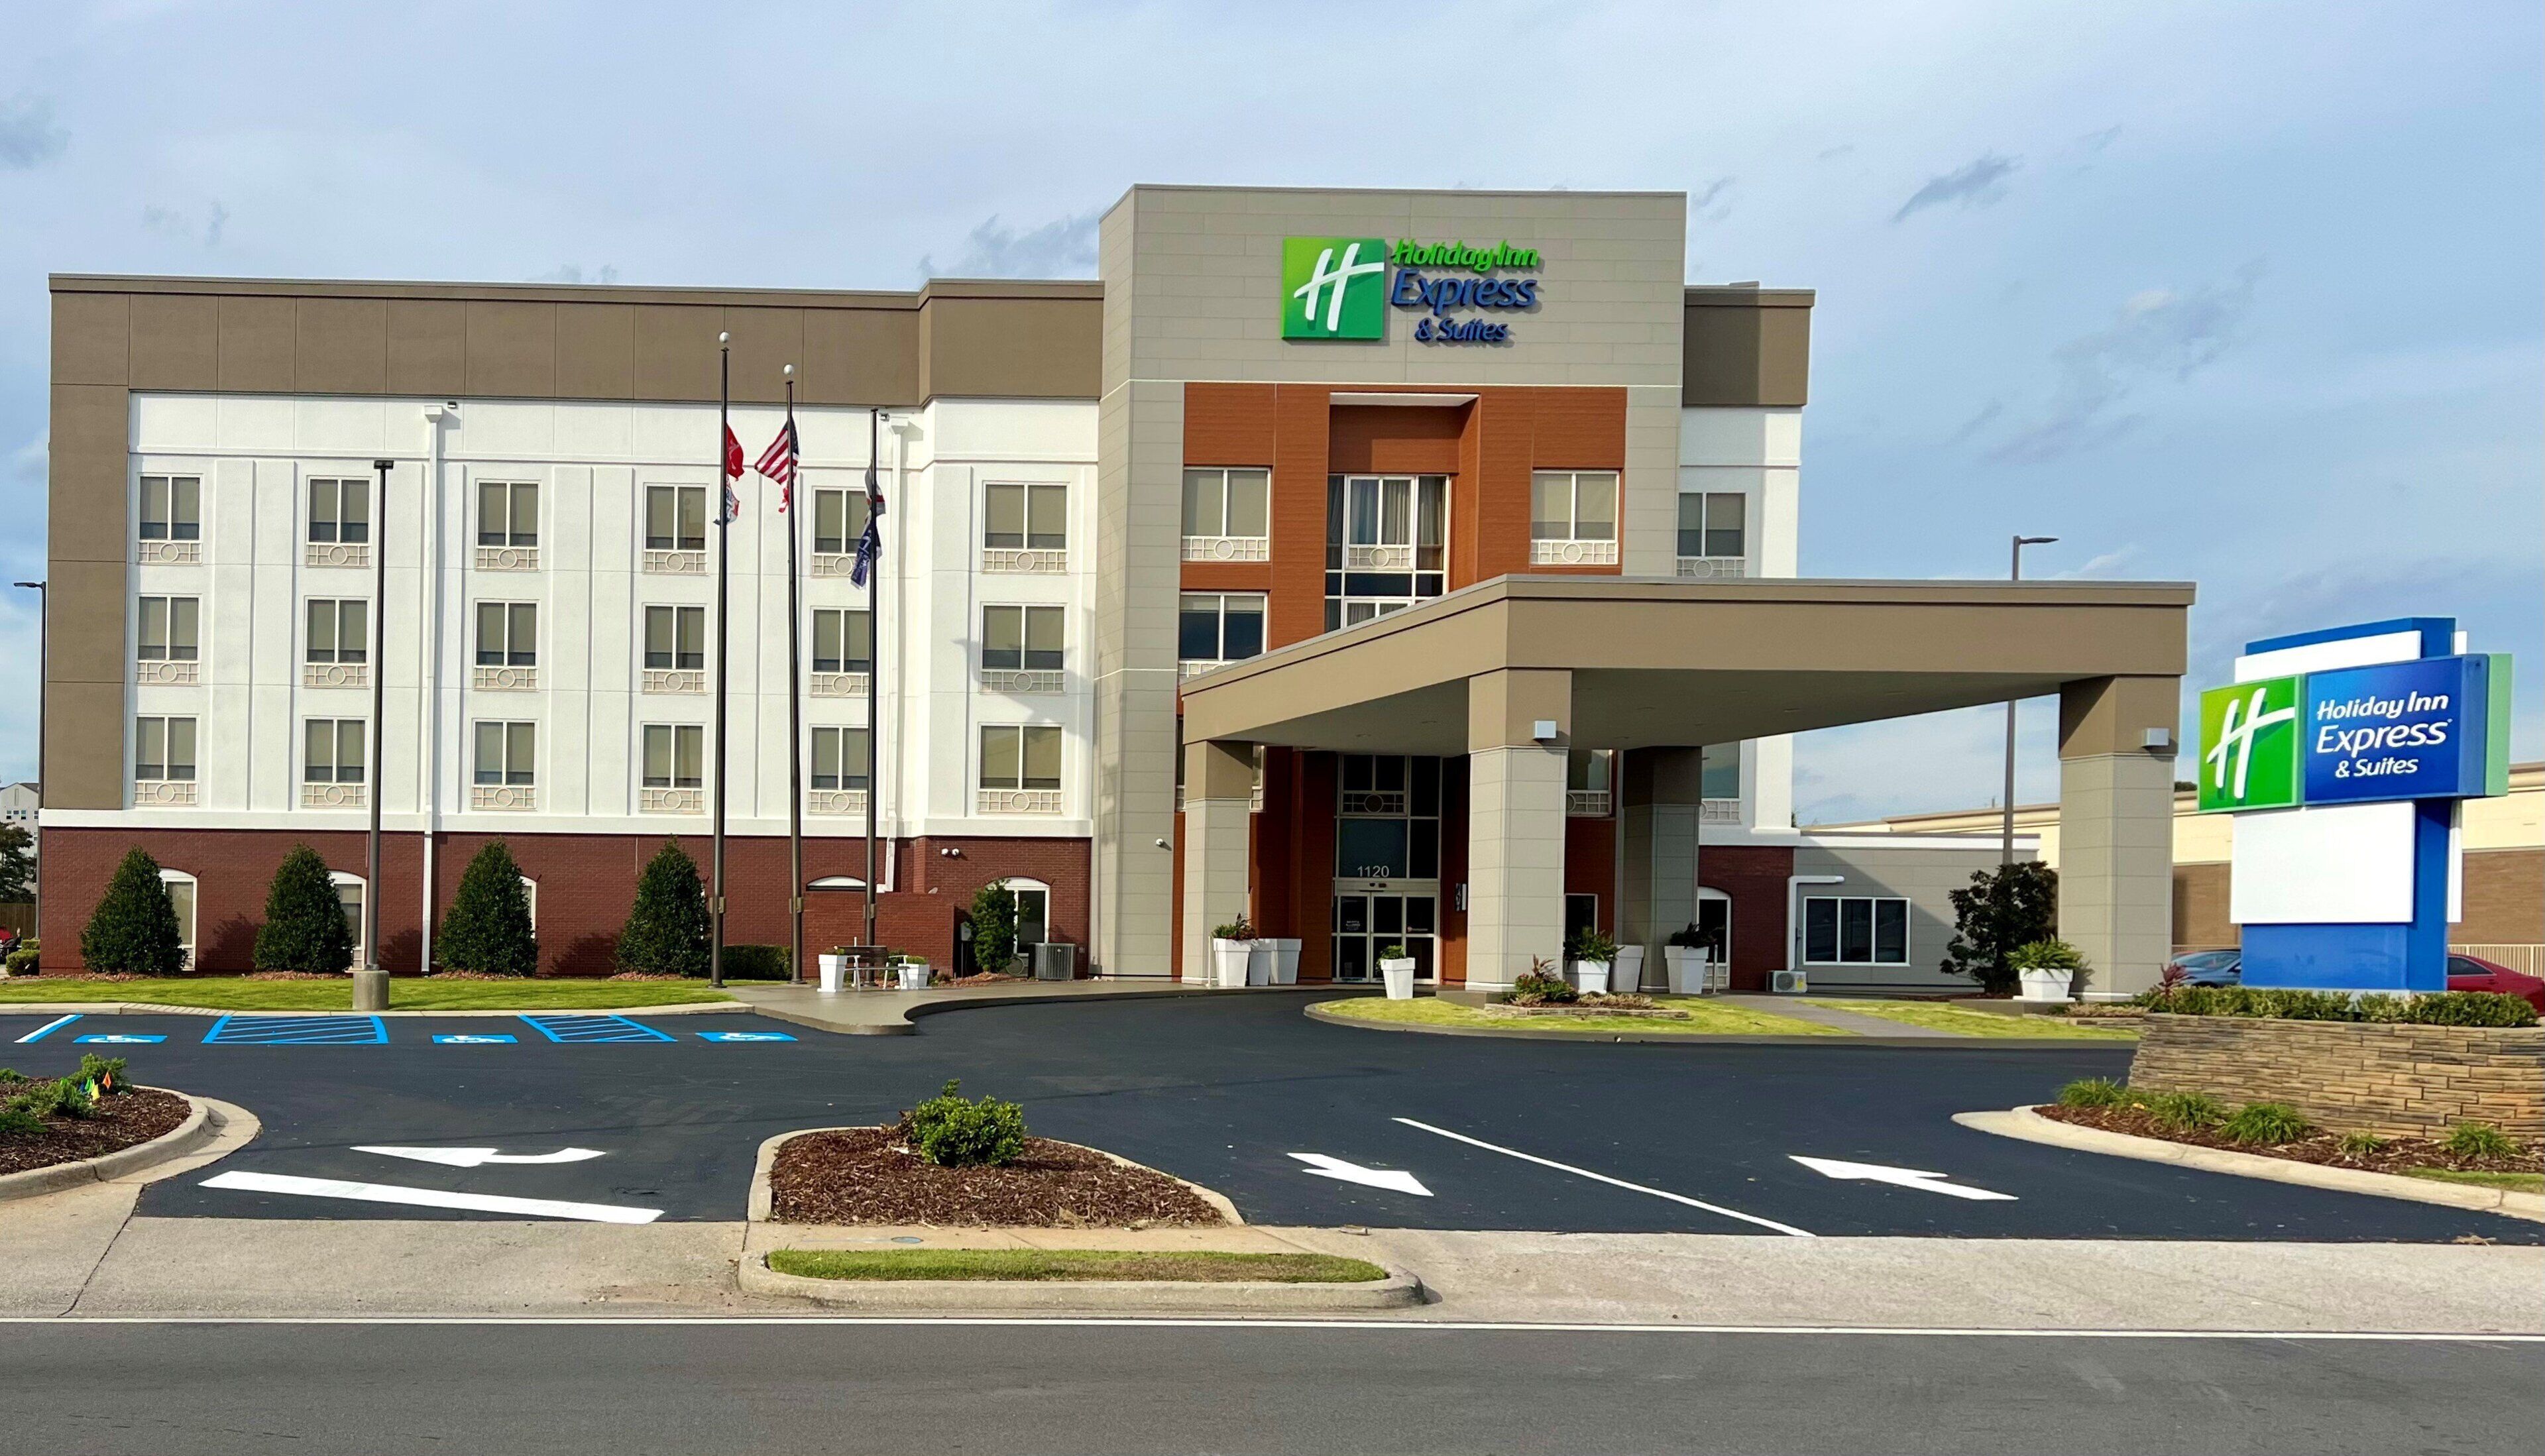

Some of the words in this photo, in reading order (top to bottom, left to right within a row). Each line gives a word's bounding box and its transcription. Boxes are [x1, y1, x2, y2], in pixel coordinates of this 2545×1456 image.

[1391, 239, 1493, 272] Holiday
[1496, 239, 1539, 266] Inn
[1391, 268, 1538, 316] Express
[1414, 317, 1433, 341] &
[1437, 317, 1508, 341] Suites
[2317, 695, 2405, 720] Holiday
[2406, 691, 2450, 712] Inn
[2316, 721, 2449, 758] Express
[2335, 760, 2351, 778] &
[2353, 757, 2419, 777] Suites
[1357, 865, 1390, 877] 1120
